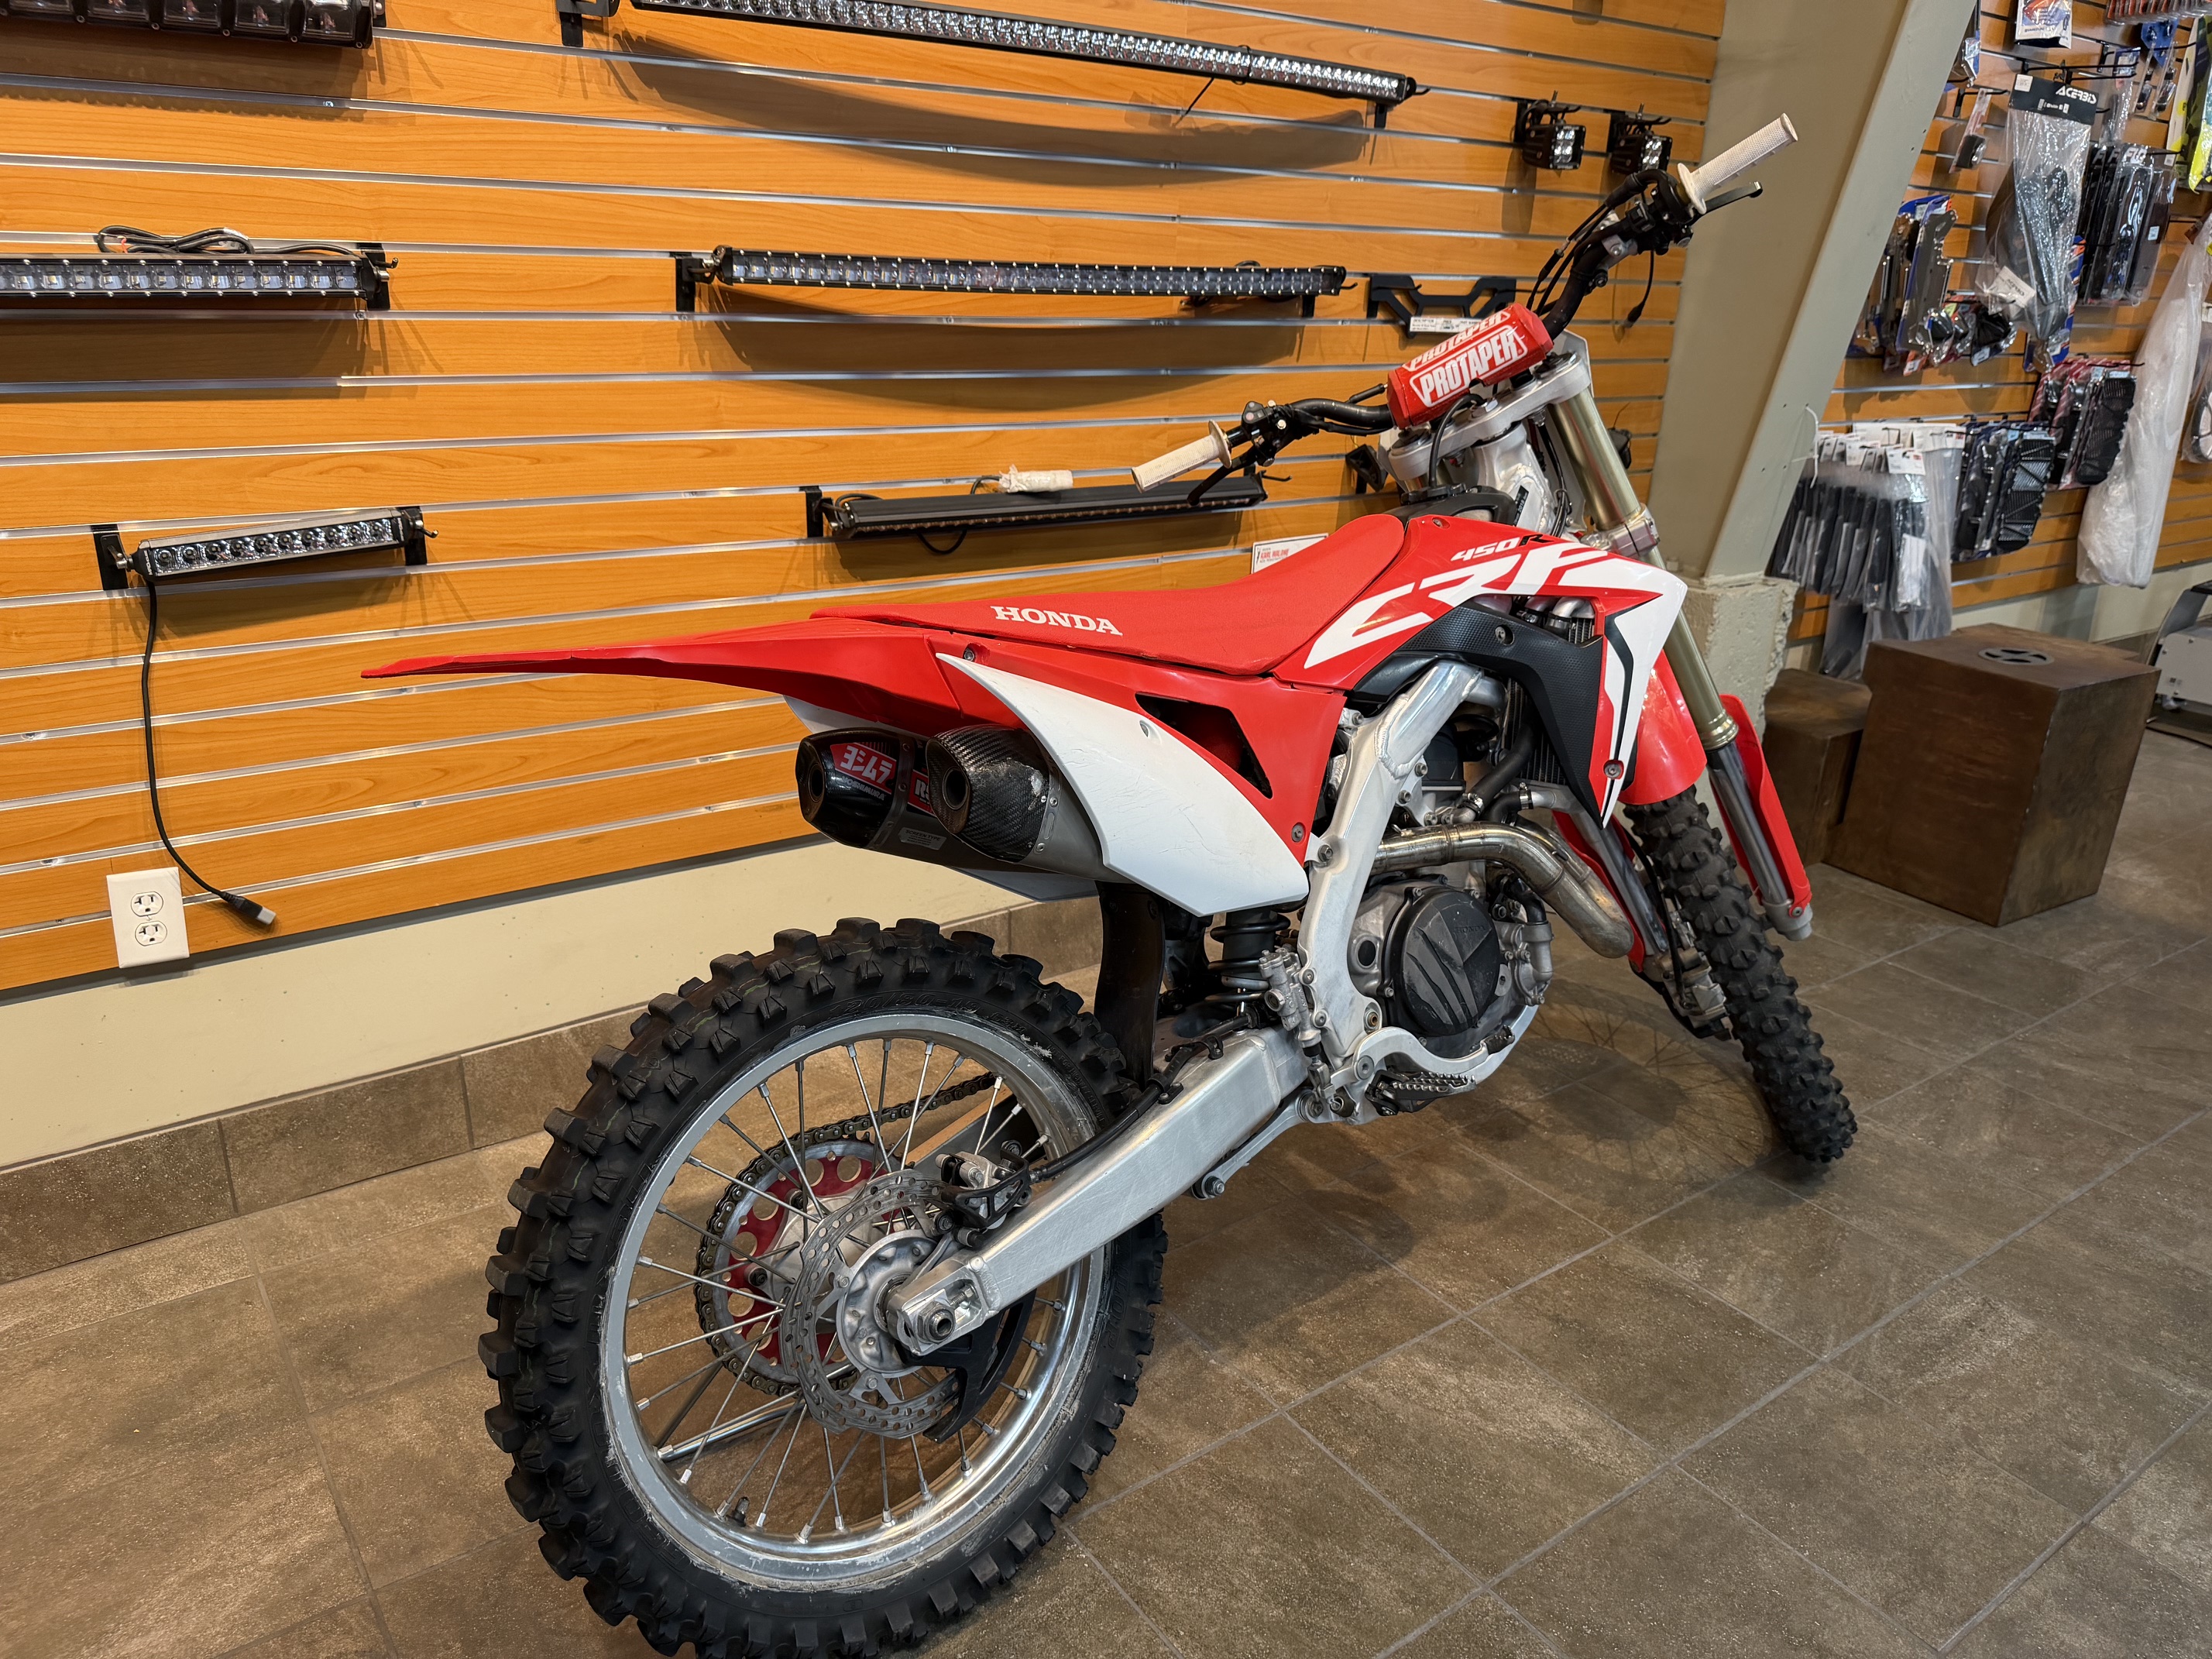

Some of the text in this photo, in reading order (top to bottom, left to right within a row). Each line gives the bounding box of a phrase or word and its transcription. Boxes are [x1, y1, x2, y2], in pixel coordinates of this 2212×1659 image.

[2056, 85, 2097, 105] ACERBIS
[1410, 311, 1506, 370] PROTAPER
[1420, 328, 1519, 407] PROTAPER
[1451, 534, 1554, 562] 450R
[1304, 542, 1608, 669] CRF
[990, 606, 1123, 636] HONDA
[840, 745, 893, 785] ヨシムラ
[842, 775, 885, 802] YOSHIMURA
[905, 830, 927, 838] SCREEN
